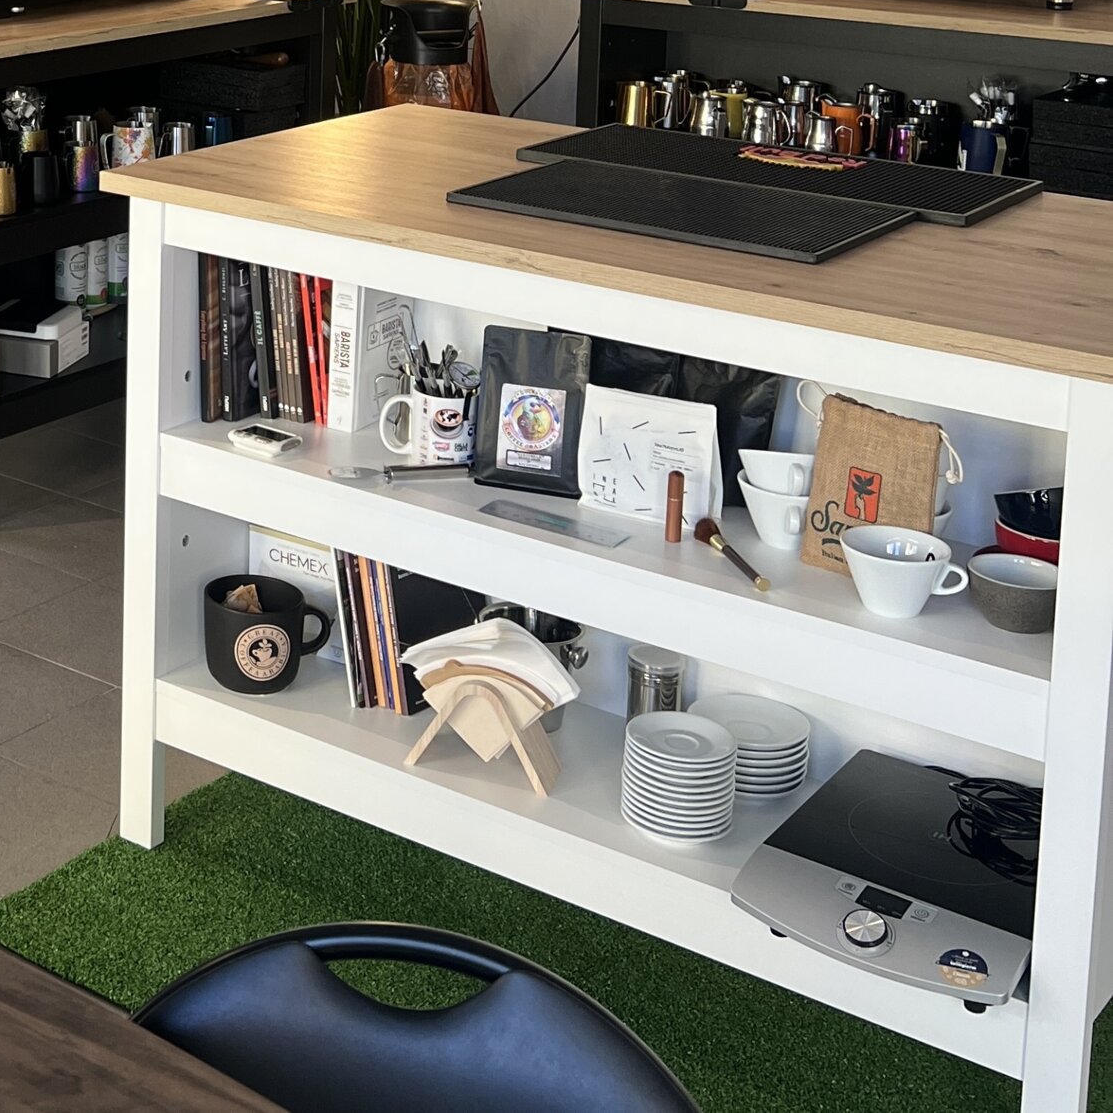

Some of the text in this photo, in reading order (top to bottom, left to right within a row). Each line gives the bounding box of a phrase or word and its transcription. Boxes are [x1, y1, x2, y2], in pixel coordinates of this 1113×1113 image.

[253, 310, 263, 336] CAFFÈ
[333, 332, 341, 364] SAPIENS
[340, 331, 351, 368] BARISTA
[269, 547, 329, 577] CHEMEX
